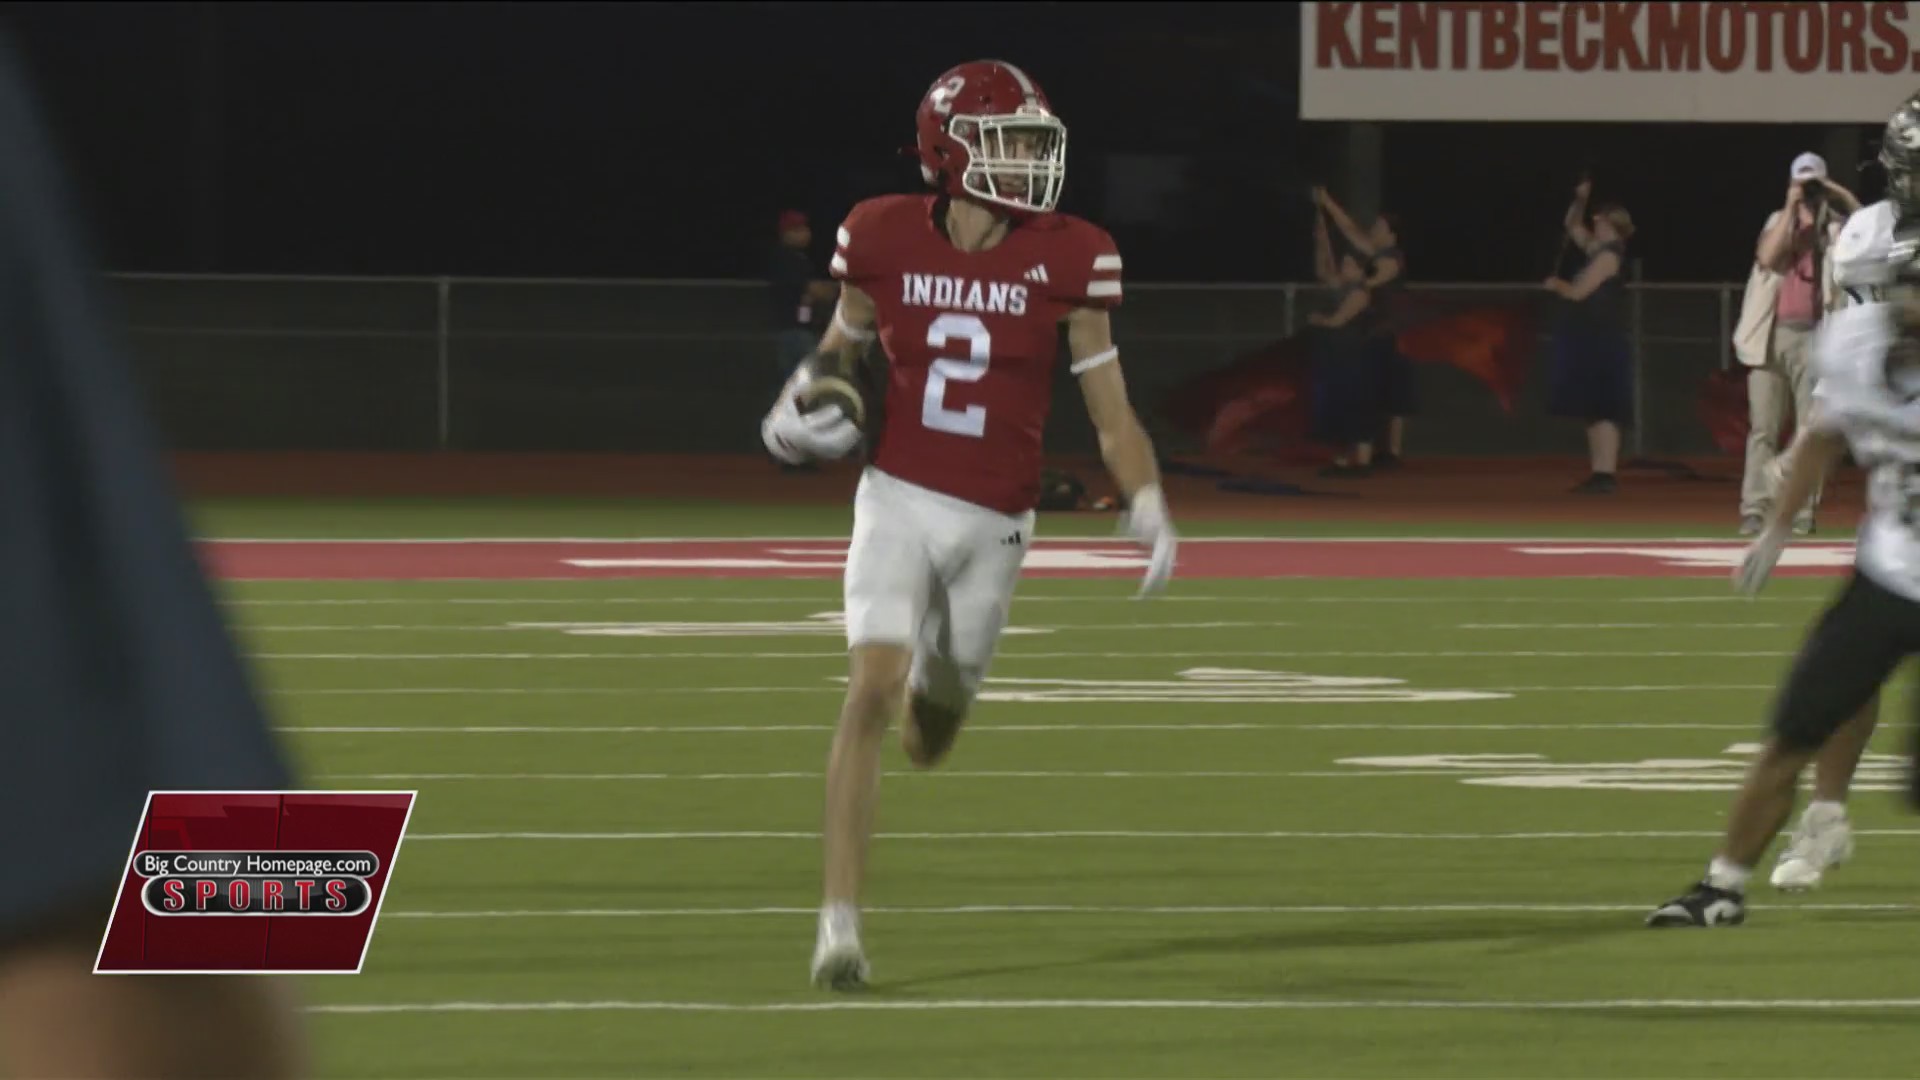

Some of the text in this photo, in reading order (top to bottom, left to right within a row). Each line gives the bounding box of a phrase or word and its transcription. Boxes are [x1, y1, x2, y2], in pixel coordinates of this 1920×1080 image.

[930, 75, 966, 116] 2
[902, 273, 1028, 315] INDIANS
[922, 312, 991, 438] 2
